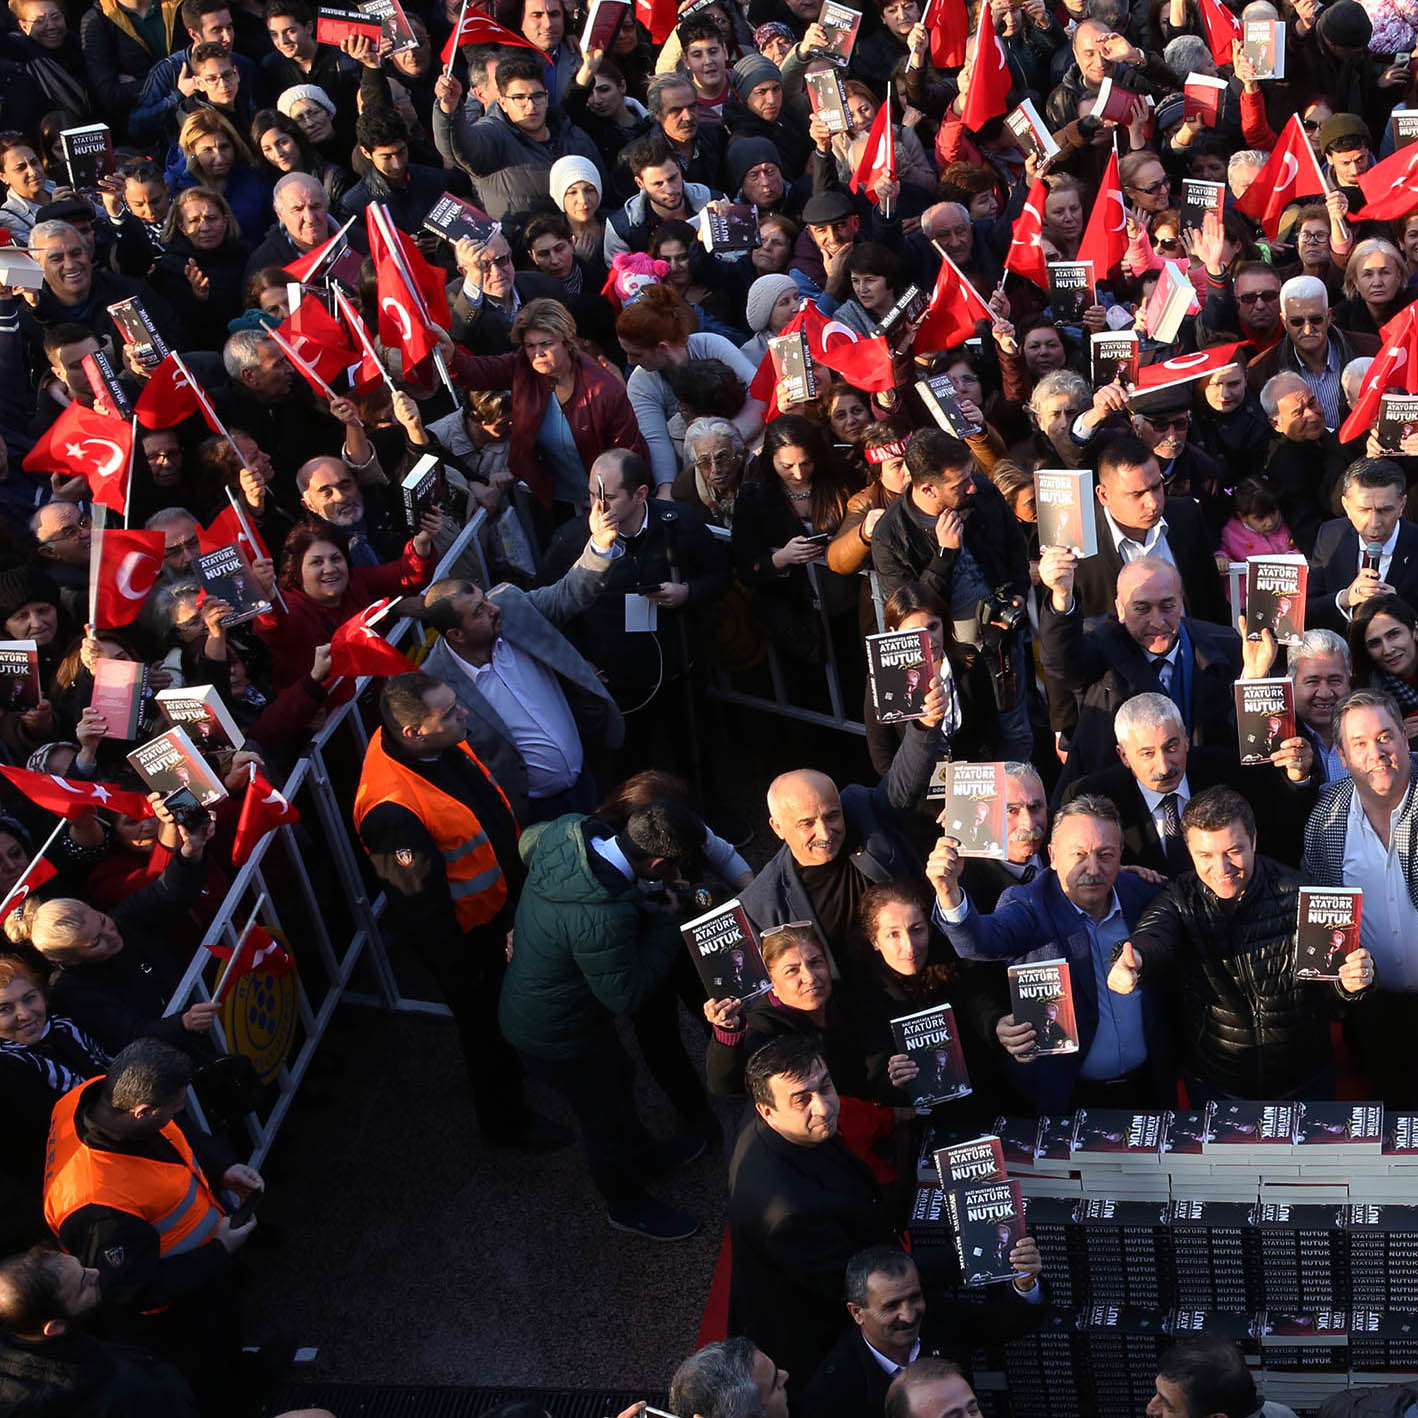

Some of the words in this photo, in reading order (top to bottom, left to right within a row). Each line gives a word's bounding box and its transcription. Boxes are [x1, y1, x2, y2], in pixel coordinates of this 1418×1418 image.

[73, 134, 105, 145] ATATÜRK
[74, 142, 107, 156] NUTUK
[1187, 186, 1218, 197] ATATÜRK
[429, 196, 450, 221] ATATÜRK
[1186, 196, 1218, 208] NUTUK
[440, 204, 462, 228] NUTUK
[1054, 269, 1086, 278] ATATÜRK
[1055, 278, 1089, 289] NUTUK
[1099, 342, 1132, 351] ATATÜRK
[1099, 350, 1132, 360] NUTUK
[95, 351, 114, 377] ATATÜRK
[110, 380, 124, 405] NUTUK
[1386, 403, 1418, 412] ATATÜRK
[1386, 412, 1418, 420] NUTUK
[200, 549, 236, 569] ATATÜRK
[205, 560, 241, 580] NUTUK
[1257, 568, 1299, 579] ATATÜRK
[1256, 580, 1296, 591] NUTUK
[879, 637, 921, 652] ATATÜRK
[0, 654, 28, 663] ATÜRK
[881, 650, 922, 667] NUTUK
[0, 665, 29, 674] UTUK
[1243, 688, 1284, 698] ATATÜRK
[165, 701, 203, 711] ATATÜRK
[1243, 700, 1285, 712] NUTUK
[169, 708, 208, 721] NUTUK
[139, 741, 171, 764] ATATÜRK
[143, 751, 180, 776] NUTUK
[954, 769, 995, 780] ATATÜRK
[953, 782, 995, 795] NUTUK
[1309, 898, 1353, 909] ATATÜRK
[1308, 912, 1353, 924] NUTUK
[694, 916, 737, 942] ATATÜRK
[698, 928, 743, 957] NUTUK
[1017, 970, 1059, 984] ATATÜRK
[1019, 985, 1062, 999] NUTUK
[903, 1016, 946, 1036] ATATÜRK
[905, 1030, 949, 1050] NUTUK
[1262, 1105, 1274, 1139] NUTUK
[1276, 1106, 1287, 1138] ATATÜRK
[1351, 1106, 1362, 1138] NUTUK
[1368, 1106, 1376, 1137] ATATÜRK
[1129, 1115, 1140, 1147] NUTUK
[1145, 1115, 1156, 1147] ATATÜRK
[1396, 1116, 1407, 1150] NUTUK
[949, 1147, 994, 1165] ATATÜRK
[951, 1161, 996, 1181] NUTUK
[916, 1188, 929, 1220] ATATÜRK
[929, 1188, 944, 1221] NUTUK
[966, 1190, 1011, 1204] ATATÜRK
[968, 1203, 1014, 1222] NUTUK
[948, 1193, 960, 1232] ATATÜRK
[956, 1235, 966, 1270] NUTUK
